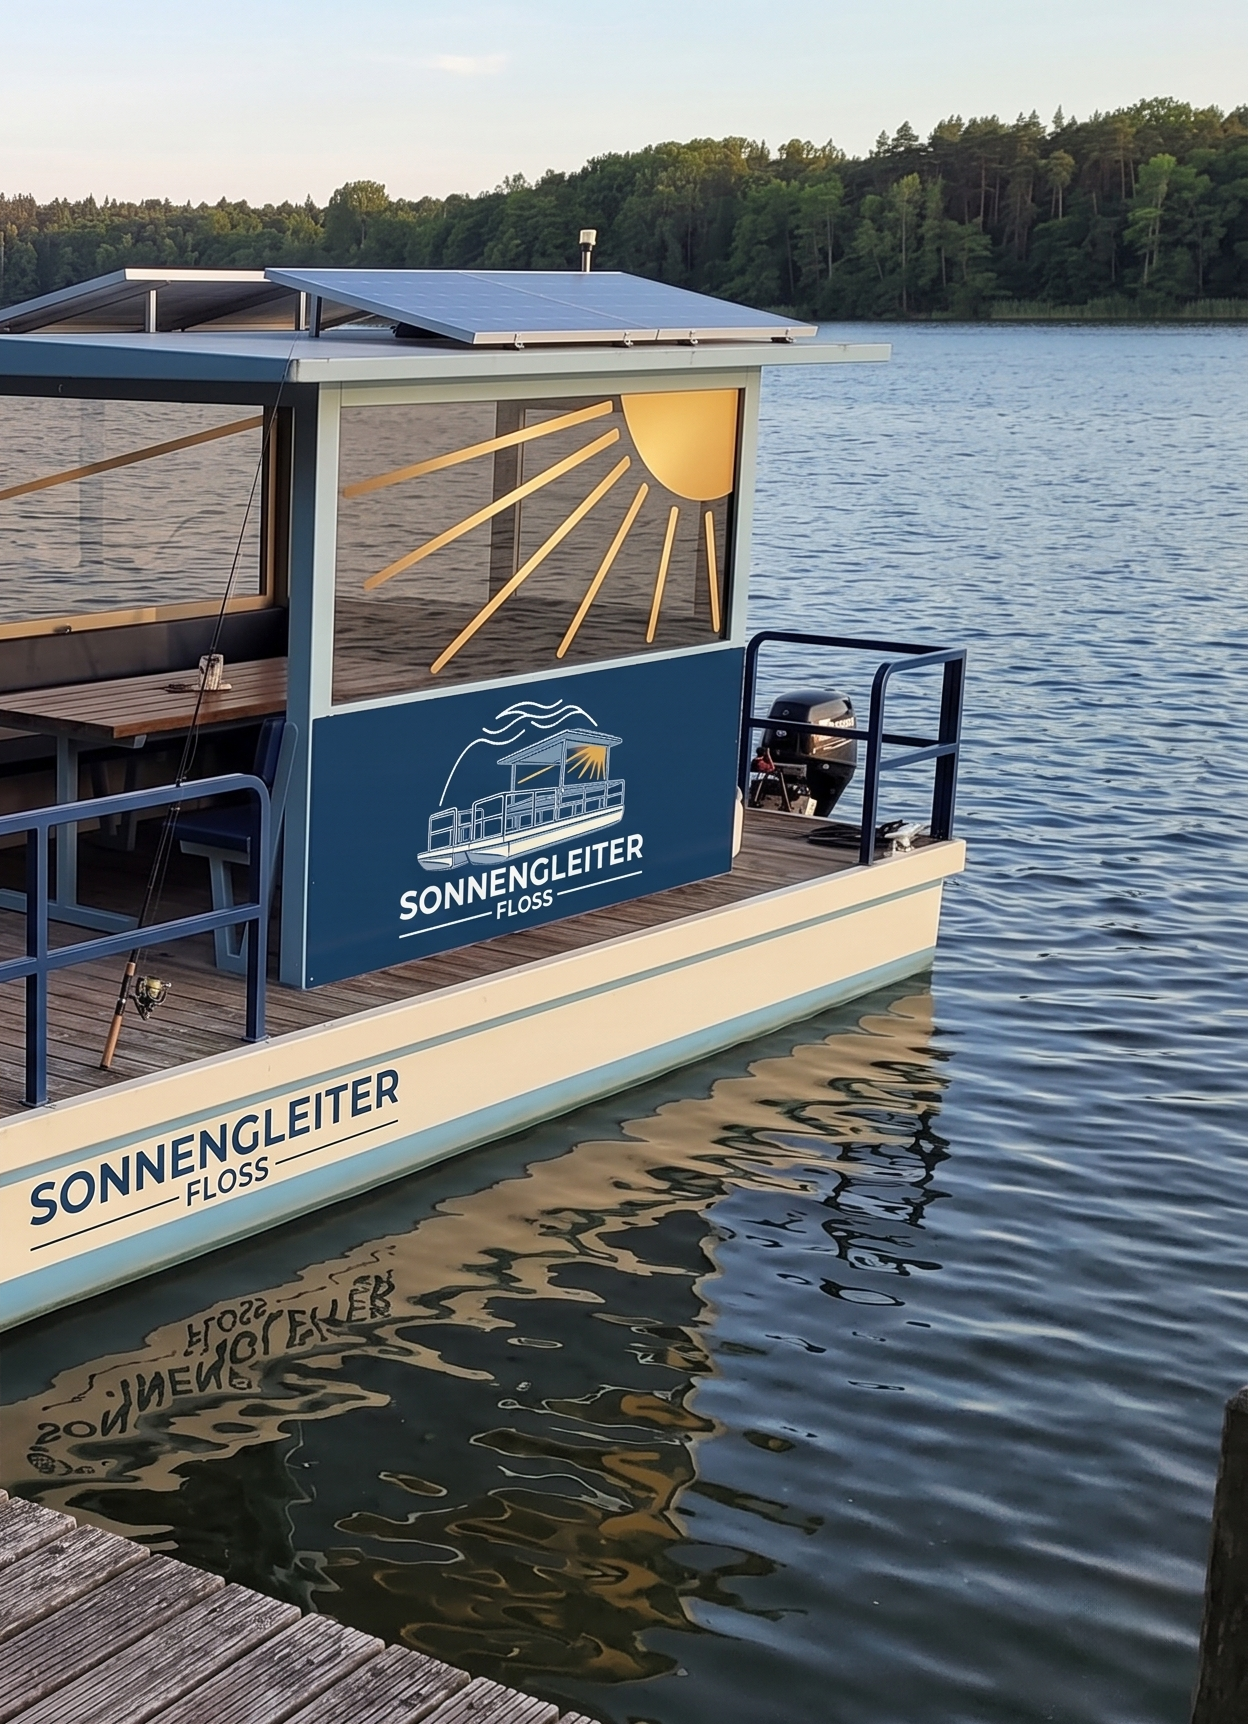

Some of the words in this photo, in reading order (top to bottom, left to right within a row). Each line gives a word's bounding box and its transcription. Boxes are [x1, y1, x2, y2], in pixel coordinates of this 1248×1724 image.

[399, 833, 644, 921] SONNENGLEITER
[496, 889, 553, 920] FLOSS
[30, 1068, 400, 1226] SONNENGLEITER
[186, 1156, 270, 1207] FLOSS
